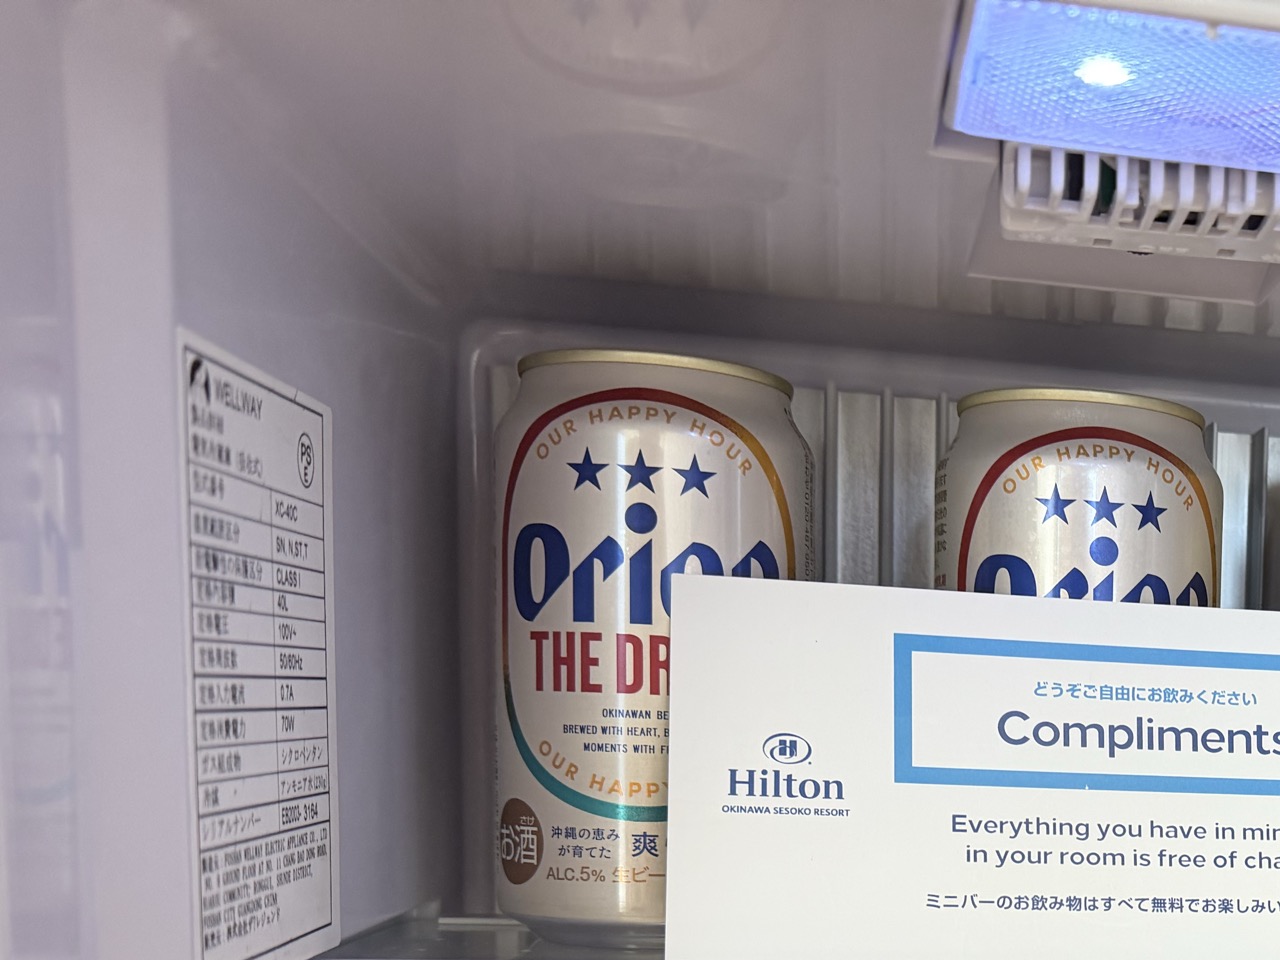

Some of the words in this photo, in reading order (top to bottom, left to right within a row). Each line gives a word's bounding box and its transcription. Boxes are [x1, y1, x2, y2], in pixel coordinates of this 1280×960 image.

[215, 379, 262, 420] WELLWAY
[536, 419, 578, 460] OUR
[589, 405, 677, 425] HAPPY
[689, 418, 754, 477] HOUR
[1002, 455, 1047, 494] OUR
[1056, 444, 1136, 463] HAPPY
[1146, 457, 1194, 511] HOUR
[530, 630, 603, 694] THE
[280, 685, 294, 701] 0.7A
[1033, 681, 1258, 706] どうぞご自由にお飲みください
[281, 716, 295, 732] 70W
[602, 708, 652, 720] OKINAWAN
[563, 724, 598, 735] BREWED
[600, 726, 623, 736] WITH
[627, 727, 660, 738] HEART,
[583, 742, 628, 753] MOMENTS
[633, 744, 655, 755] WITH
[538, 740, 579, 781] OUR
[727, 768, 845, 800] Hilton
[721, 804, 771, 815] OKINAWA
[773, 806, 811, 816] SESOKO
[814, 808, 850, 817] RESORT
[551, 825, 621, 841] 沖縄の恵み
[951, 814, 1090, 841] Everything
[1097, 822, 1143, 841] you
[1150, 820, 1207, 839] have
[1215, 822, 1235, 840] in
[501, 823, 539, 865] お酒
[558, 844, 611, 859] が育てた
[966, 845, 988, 863] in
[995, 849, 1053, 868] your
[1059, 851, 1125, 866] room
[1133, 849, 1151, 867] is
[1157, 849, 1206, 867] free
[1213, 850, 1237, 868] of
[546, 866, 605, 882] ALC.5%
